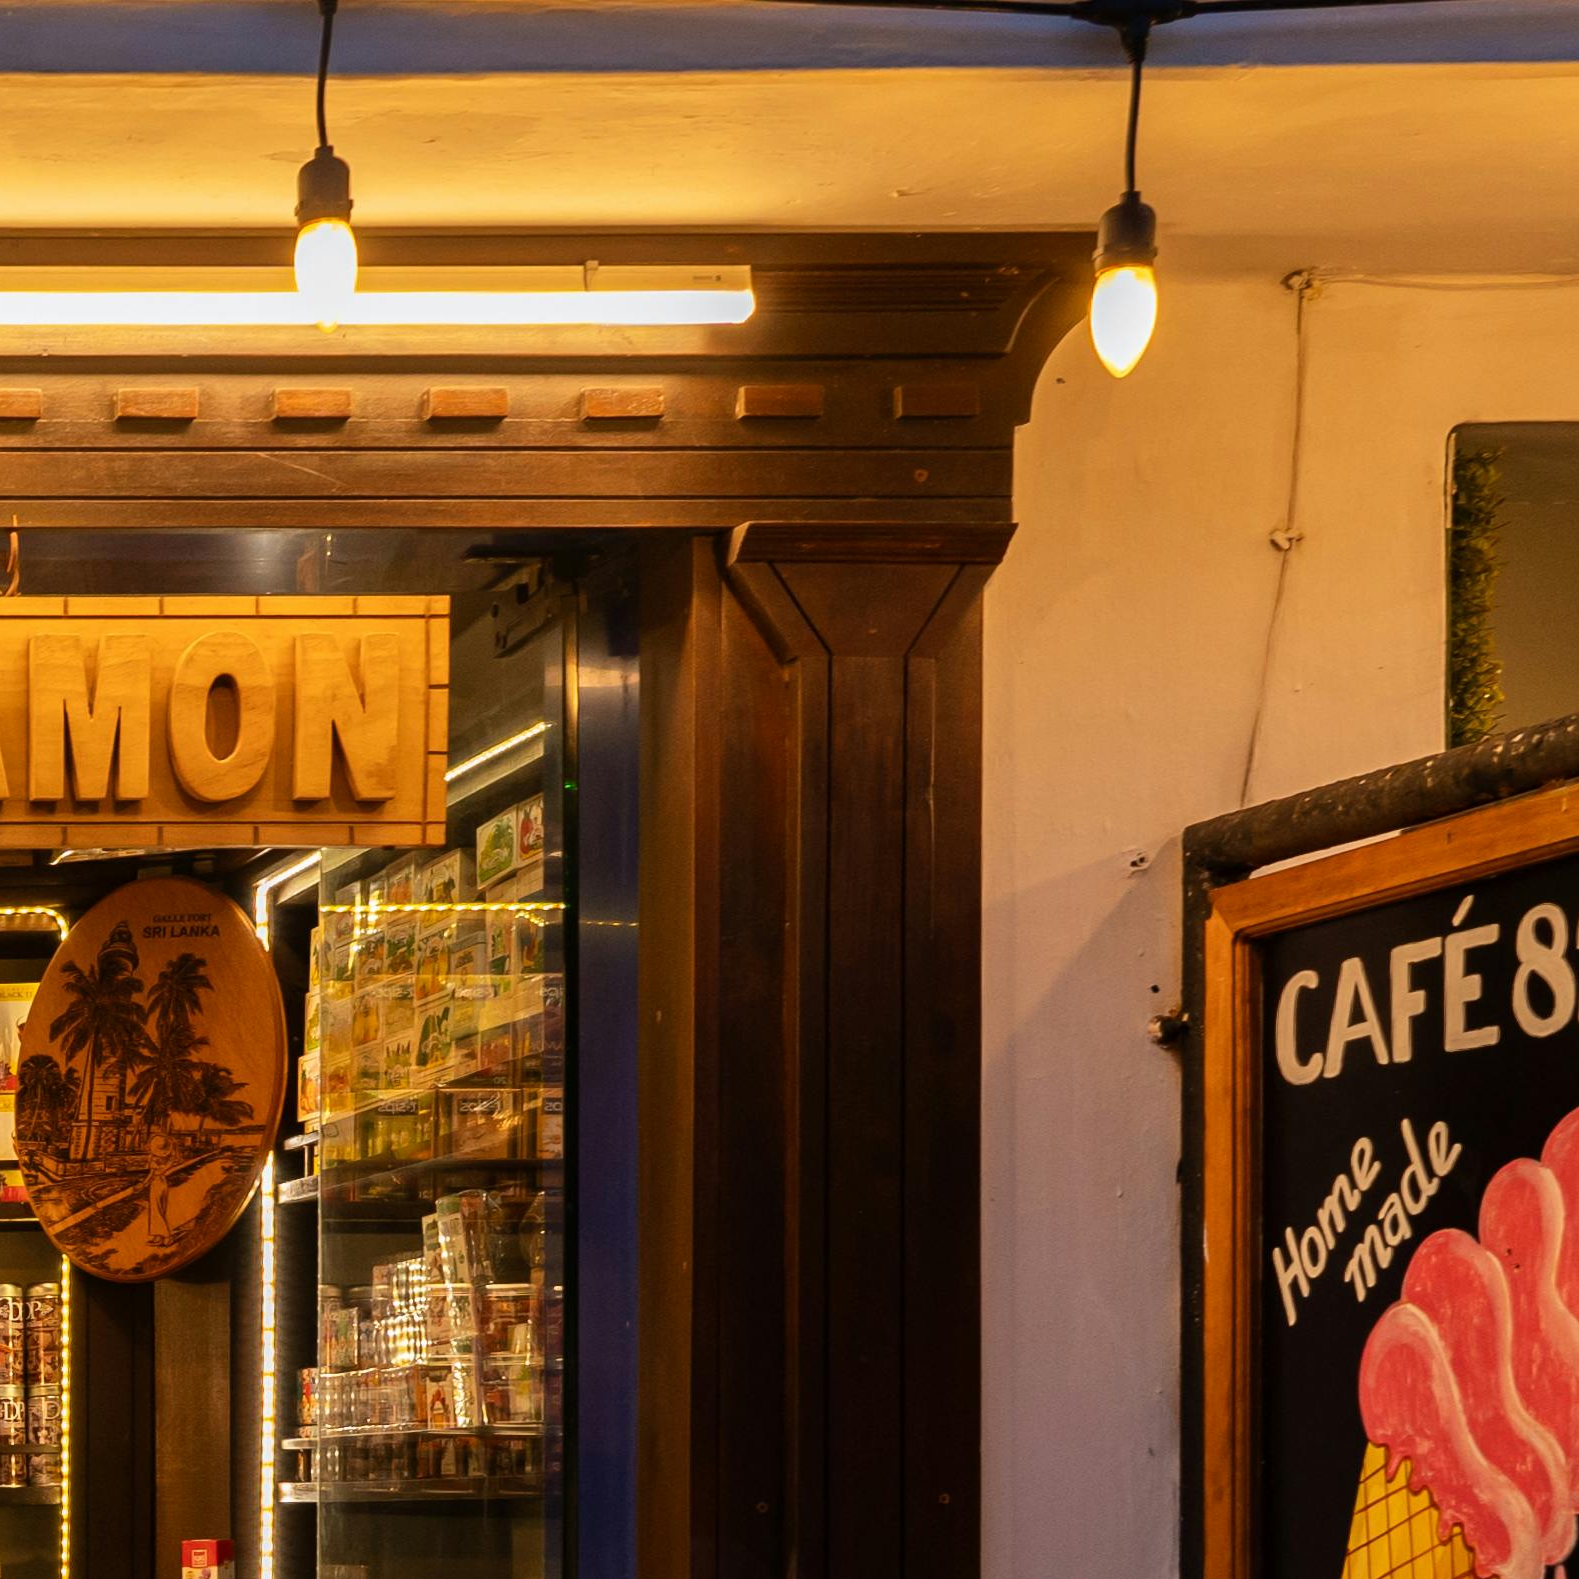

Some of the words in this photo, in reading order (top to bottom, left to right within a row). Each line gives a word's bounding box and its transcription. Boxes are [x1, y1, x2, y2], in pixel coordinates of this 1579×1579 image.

[143, 927, 167, 938] SRI
[169, 926, 221, 937] LANKA
[153, 914, 187, 923] GALLE
[188, 913, 212, 922] FORT
[1276, 895, 1500, 1085] CAFÉ
[1273, 1138, 1381, 1326] Home
[1344, 1118, 1462, 1302] made
